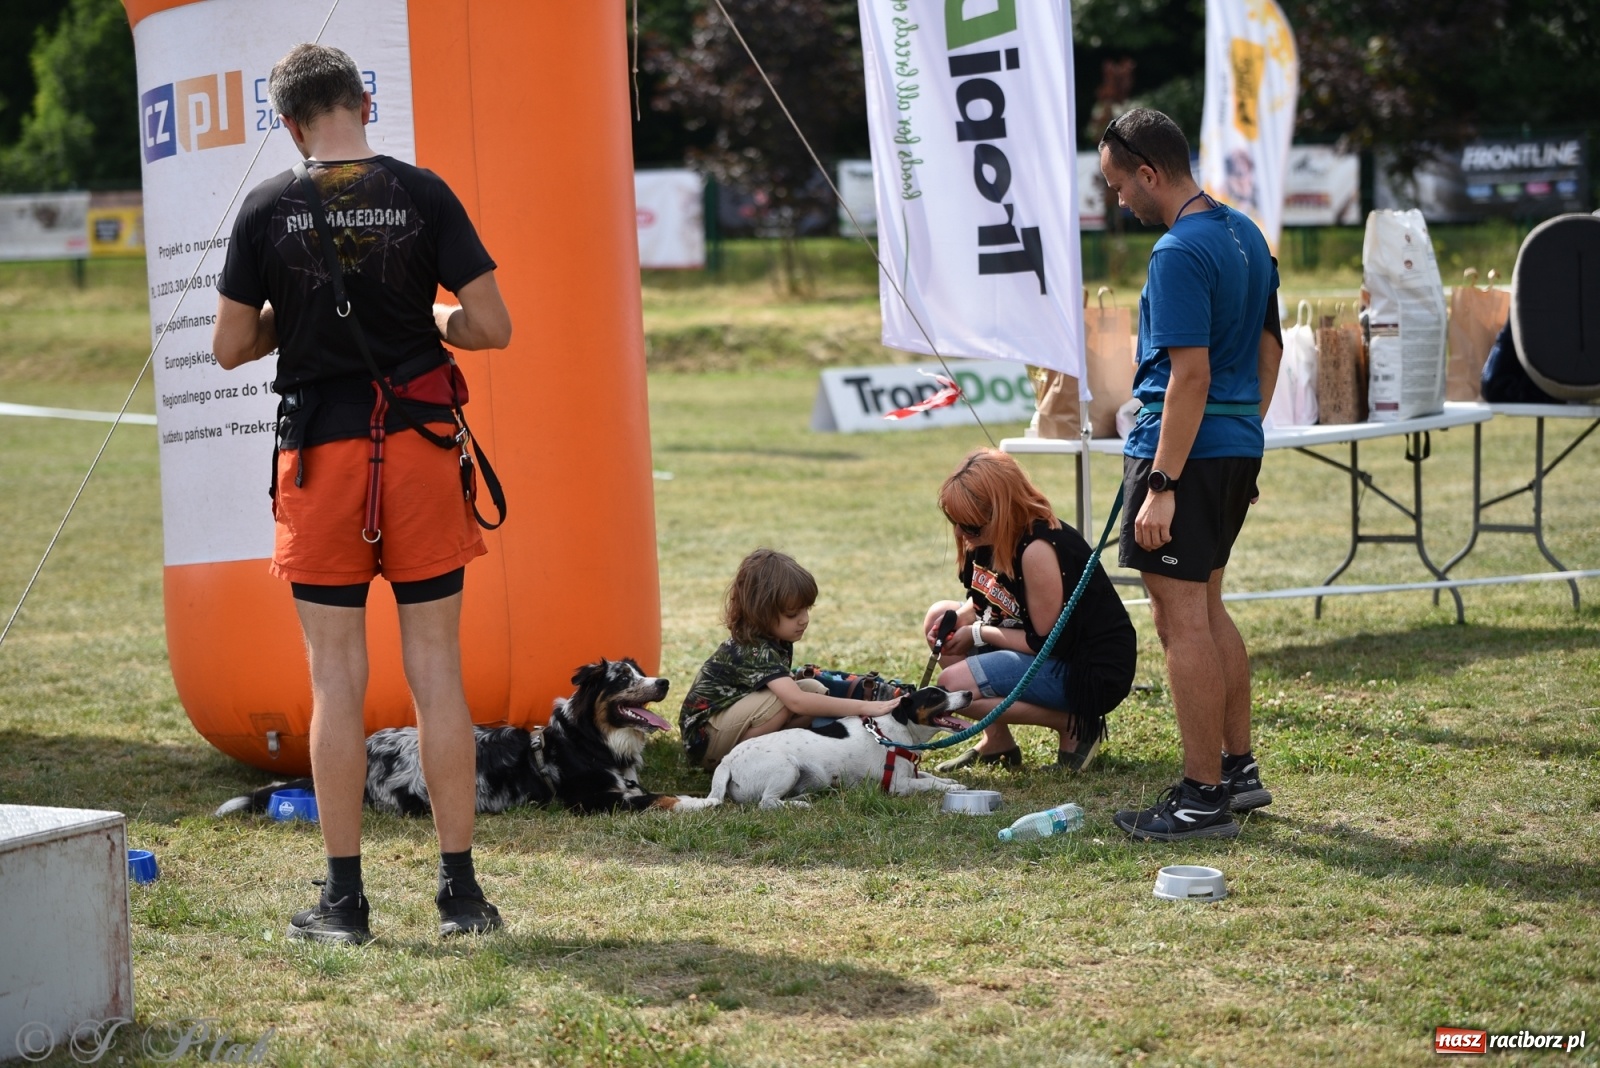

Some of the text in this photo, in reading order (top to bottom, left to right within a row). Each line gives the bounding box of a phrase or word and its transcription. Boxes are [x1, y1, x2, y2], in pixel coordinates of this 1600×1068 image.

[1461, 139, 1582, 172] FRONTLINE
[158, 237, 231, 260] Projekt o numer
[165, 350, 217, 370] Europejskieg
[162, 390, 212, 410] Regionalnego
[214, 387, 239, 399] oraz
[242, 383, 258, 396] do
[843, 371, 1036, 418] TropDog
[184, 426, 223, 444] państwa
